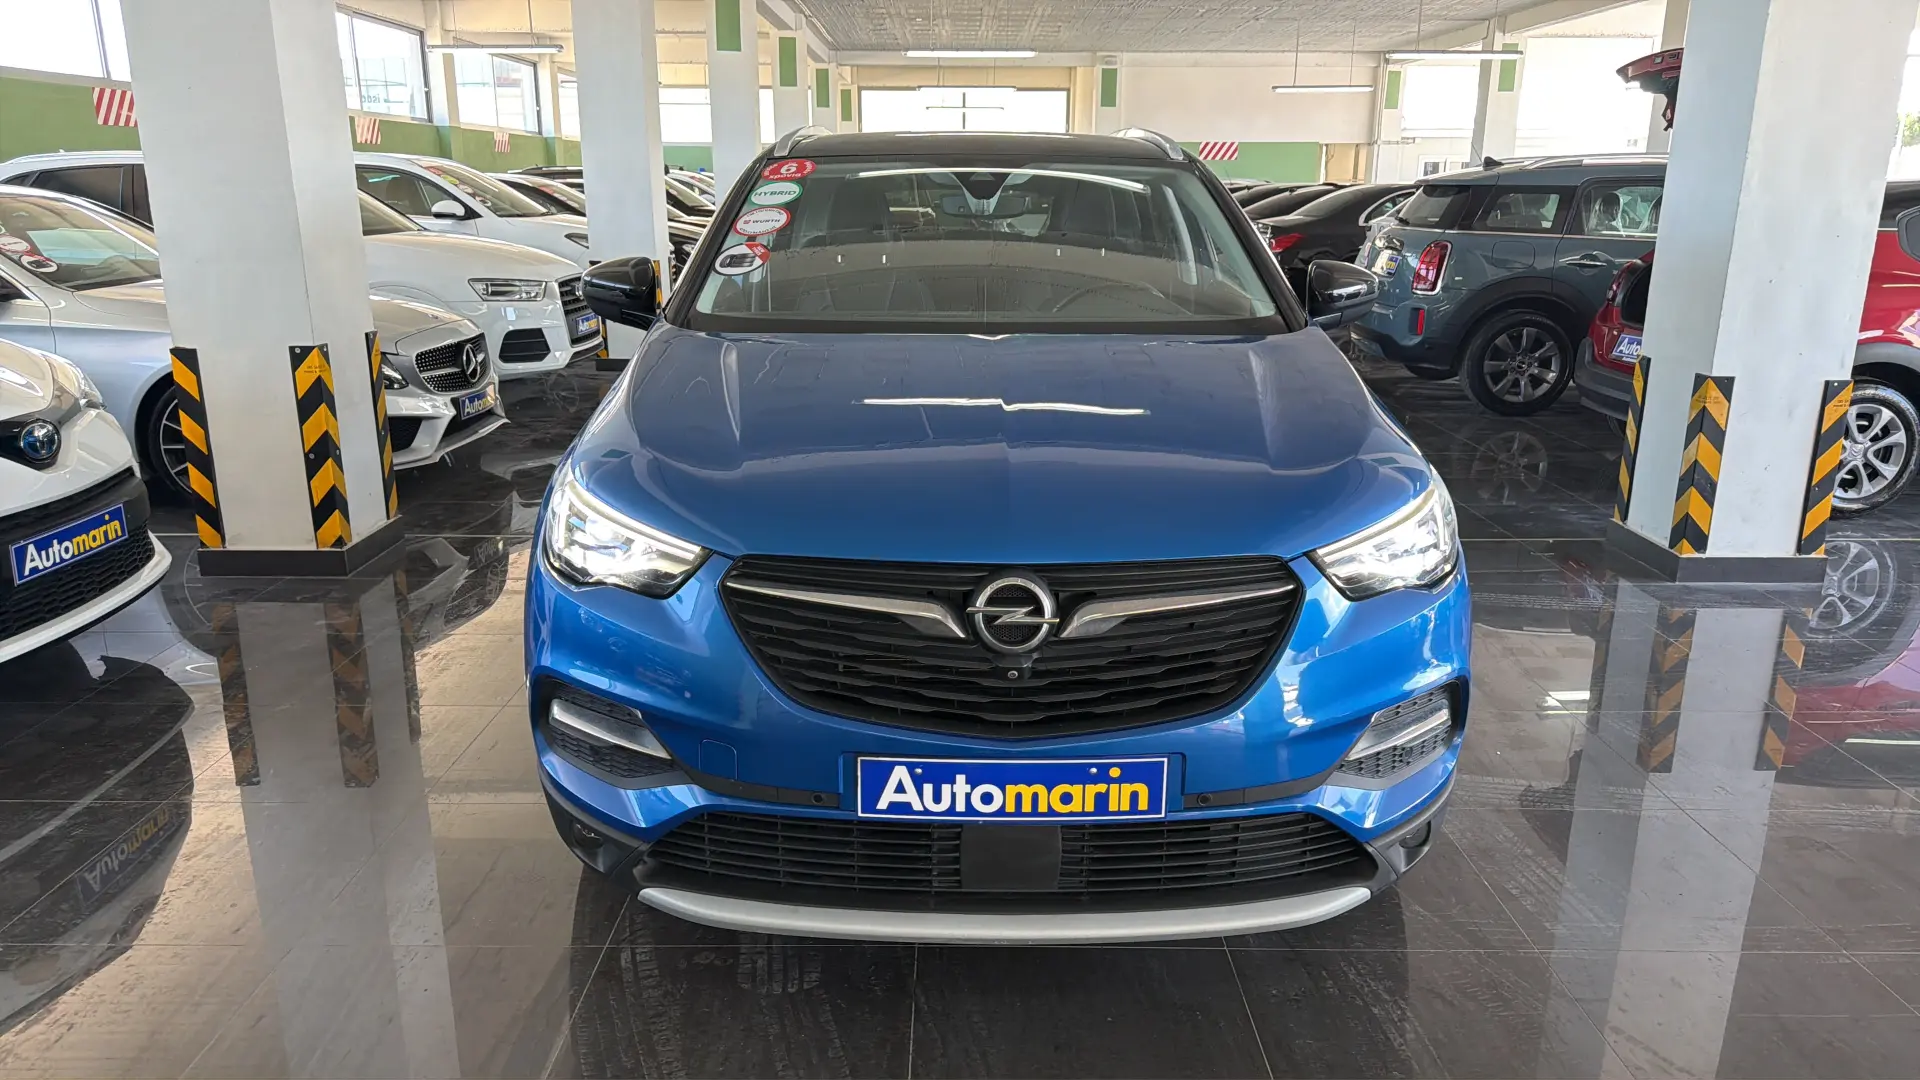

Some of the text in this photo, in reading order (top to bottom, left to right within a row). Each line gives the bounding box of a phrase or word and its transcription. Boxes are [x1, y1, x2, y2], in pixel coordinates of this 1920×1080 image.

[780, 163, 798, 174] 6
[1616, 337, 1641, 355] Auto
[23, 514, 122, 577] Automarin
[875, 766, 1149, 814] Automarin
